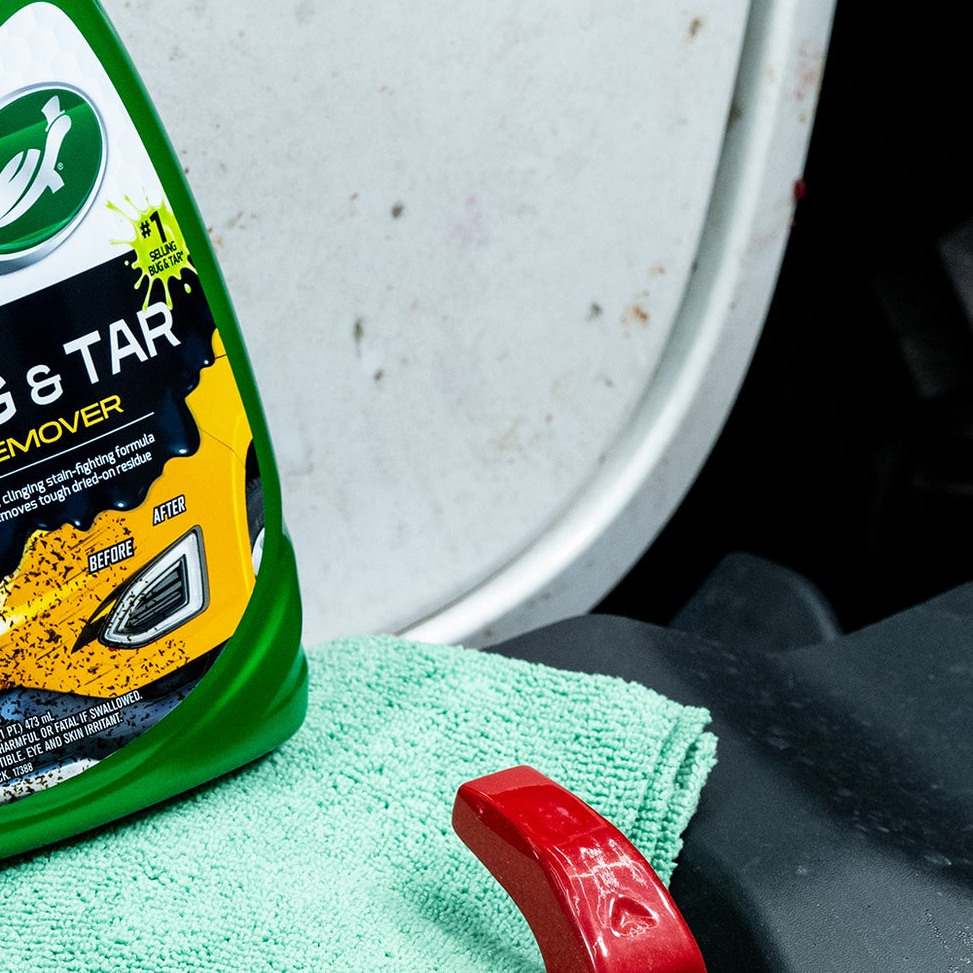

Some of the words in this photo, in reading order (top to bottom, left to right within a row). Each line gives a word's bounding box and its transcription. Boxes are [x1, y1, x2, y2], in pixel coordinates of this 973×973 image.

[140, 211, 167, 243] #1
[148, 260, 164, 276] BUG
[163, 257, 170, 268] &
[149, 241, 177, 262] SELLING
[26, 364, 64, 405] &
[63, 301, 181, 384] TAR
[2, 480, 45, 504] clinging
[46, 452, 116, 487] stain-fighting
[115, 433, 155, 458] formula
[39, 484, 72, 505] tough
[72, 469, 115, 493] dried-on
[117, 451, 152, 475] residue
[153, 495, 186, 525] AFTER
[89, 539, 134, 572] BEFORE
[24, 716, 40, 729] 473
[41, 711, 55, 724] mL
[40, 725, 54, 738] OR
[54, 715, 79, 733] FATAL
[79, 711, 89, 724] IF
[89, 690, 143, 719] SWALLOWED.
[26, 743, 44, 758] EYE
[45, 735, 63, 752] AND
[63, 727, 84, 744] SKIN
[85, 712, 123, 736] IRRITANT.
